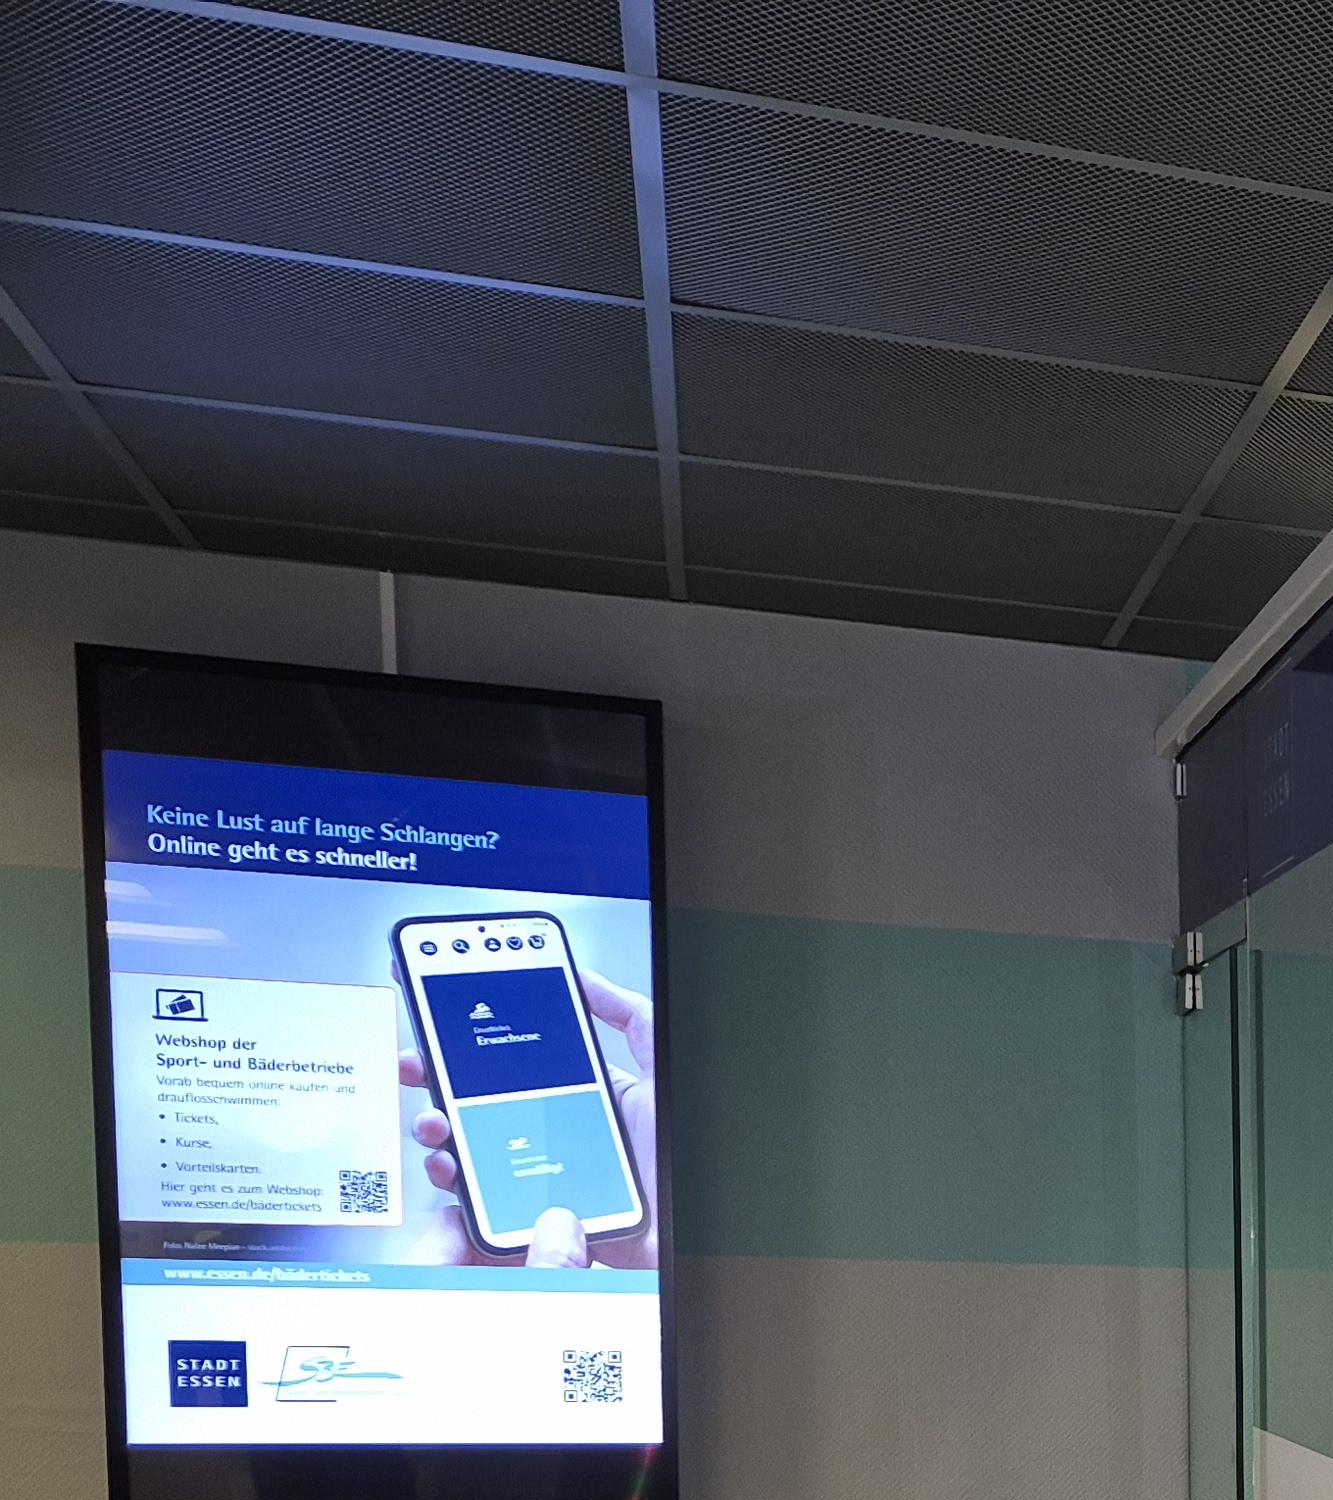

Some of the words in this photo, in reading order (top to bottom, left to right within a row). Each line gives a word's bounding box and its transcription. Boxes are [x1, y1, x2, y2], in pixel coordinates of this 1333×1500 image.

[147, 804, 209, 828] Keine
[217, 810, 264, 832] Lust
[270, 816, 311, 834] auf
[315, 817, 375, 844] lange
[380, 822, 500, 852] Schlangen?
[148, 833, 221, 856] Online
[228, 840, 280, 864] geht
[286, 846, 311, 863] es
[316, 847, 418, 871] schneller!
[155, 1033, 226, 1051] Webshop
[232, 1037, 257, 1050] der
[156, 1053, 207, 1069] Sport-
[213, 1056, 241, 1069] und
[248, 1056, 354, 1075] Bäderbetriebe
[156, 1075, 192, 1087] Vorab
[196, 1077, 244, 1090] bequem
[248, 1079, 284, 1091] online
[289, 1081, 328, 1092] kaufen
[175, 1112, 219, 1126] Tickets,
[175, 1137, 212, 1149] Kurse,
[161, 1181, 185, 1192] Hier
[189, 1183, 216, 1195] geht
[221, 1186, 233, 1194] es
[238, 1186, 262, 1194] zum
[267, 1184, 324, 1198] Webshop:
[177, 1358, 241, 1371] STADT
[177, 1375, 241, 1388] ESSEN
